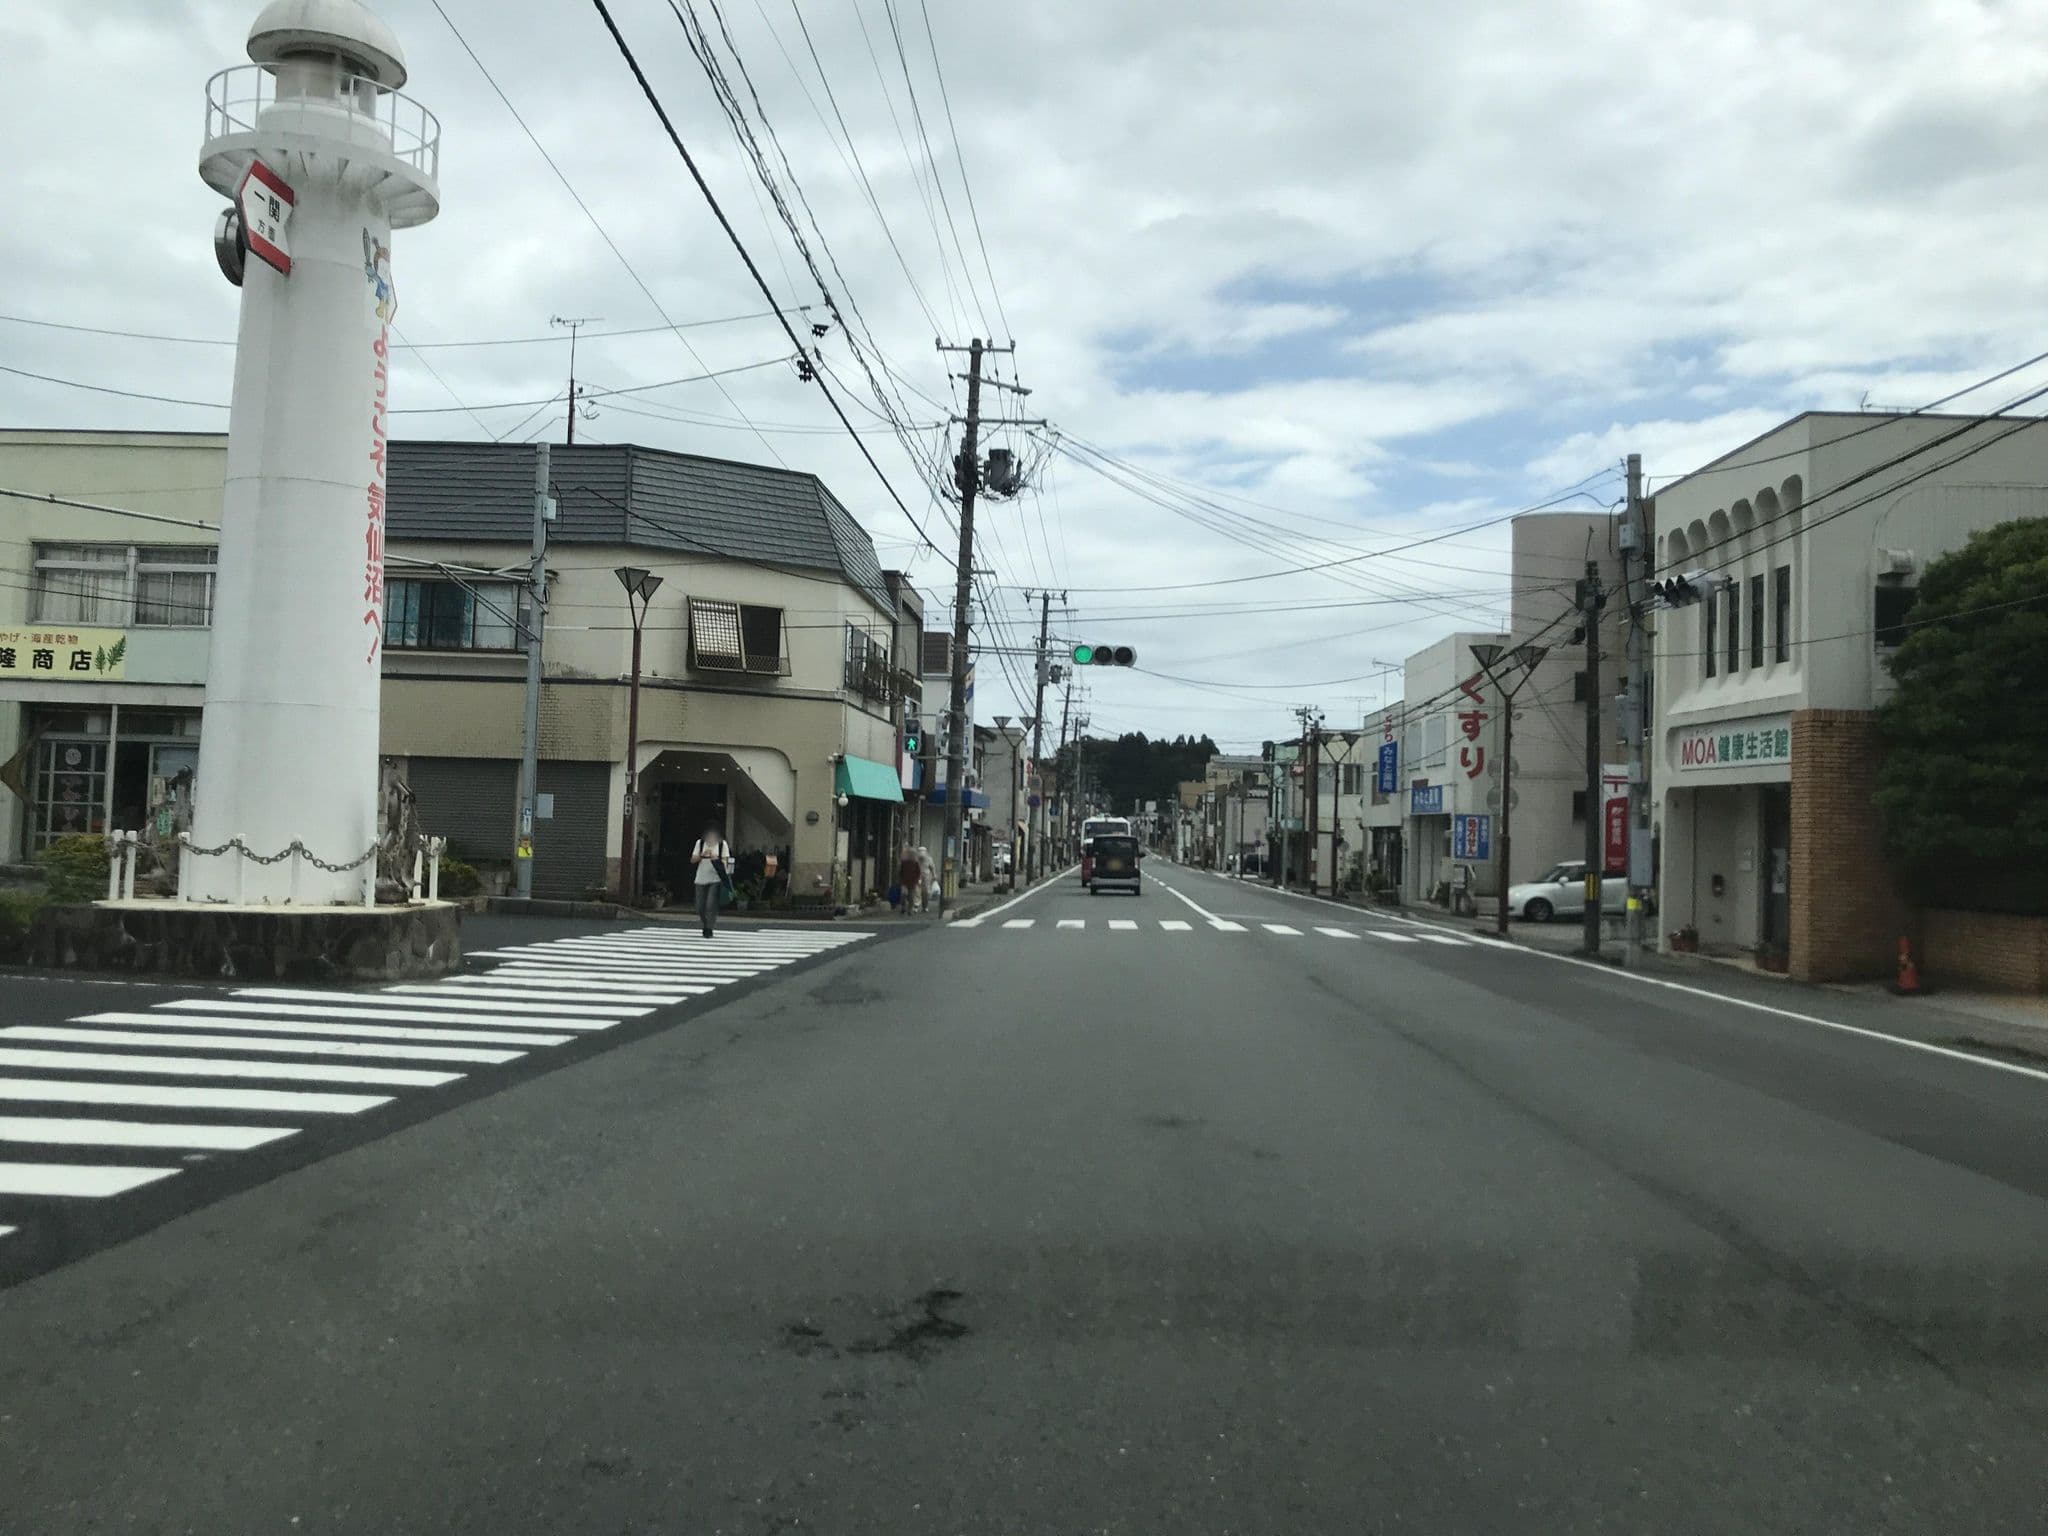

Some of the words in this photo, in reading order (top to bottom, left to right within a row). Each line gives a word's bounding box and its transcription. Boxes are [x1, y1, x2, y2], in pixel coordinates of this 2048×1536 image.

[254, 190, 280, 223] 一関
[1458, 672, 1488, 779] くすり
